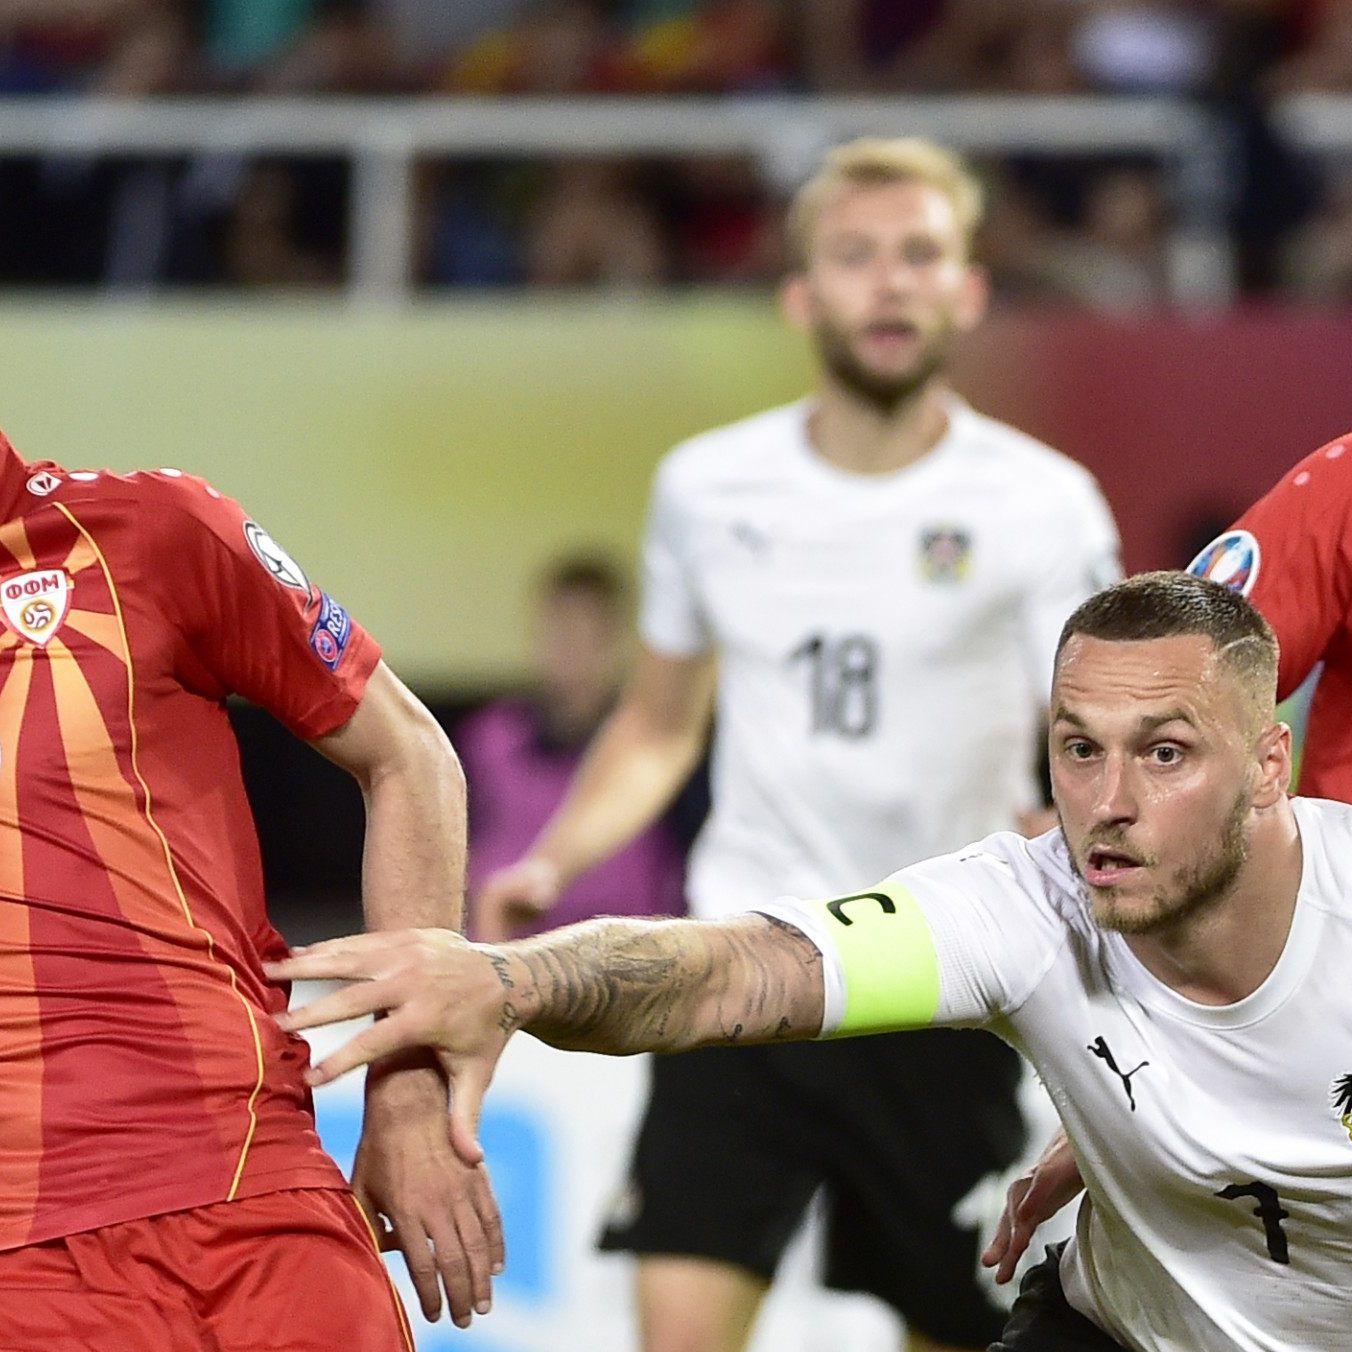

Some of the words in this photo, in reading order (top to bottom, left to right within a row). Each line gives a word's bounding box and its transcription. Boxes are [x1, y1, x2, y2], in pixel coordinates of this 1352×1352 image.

[786, 634, 879, 739] 18
[826, 892, 896, 926] C
[1214, 1181, 1289, 1264] 7
